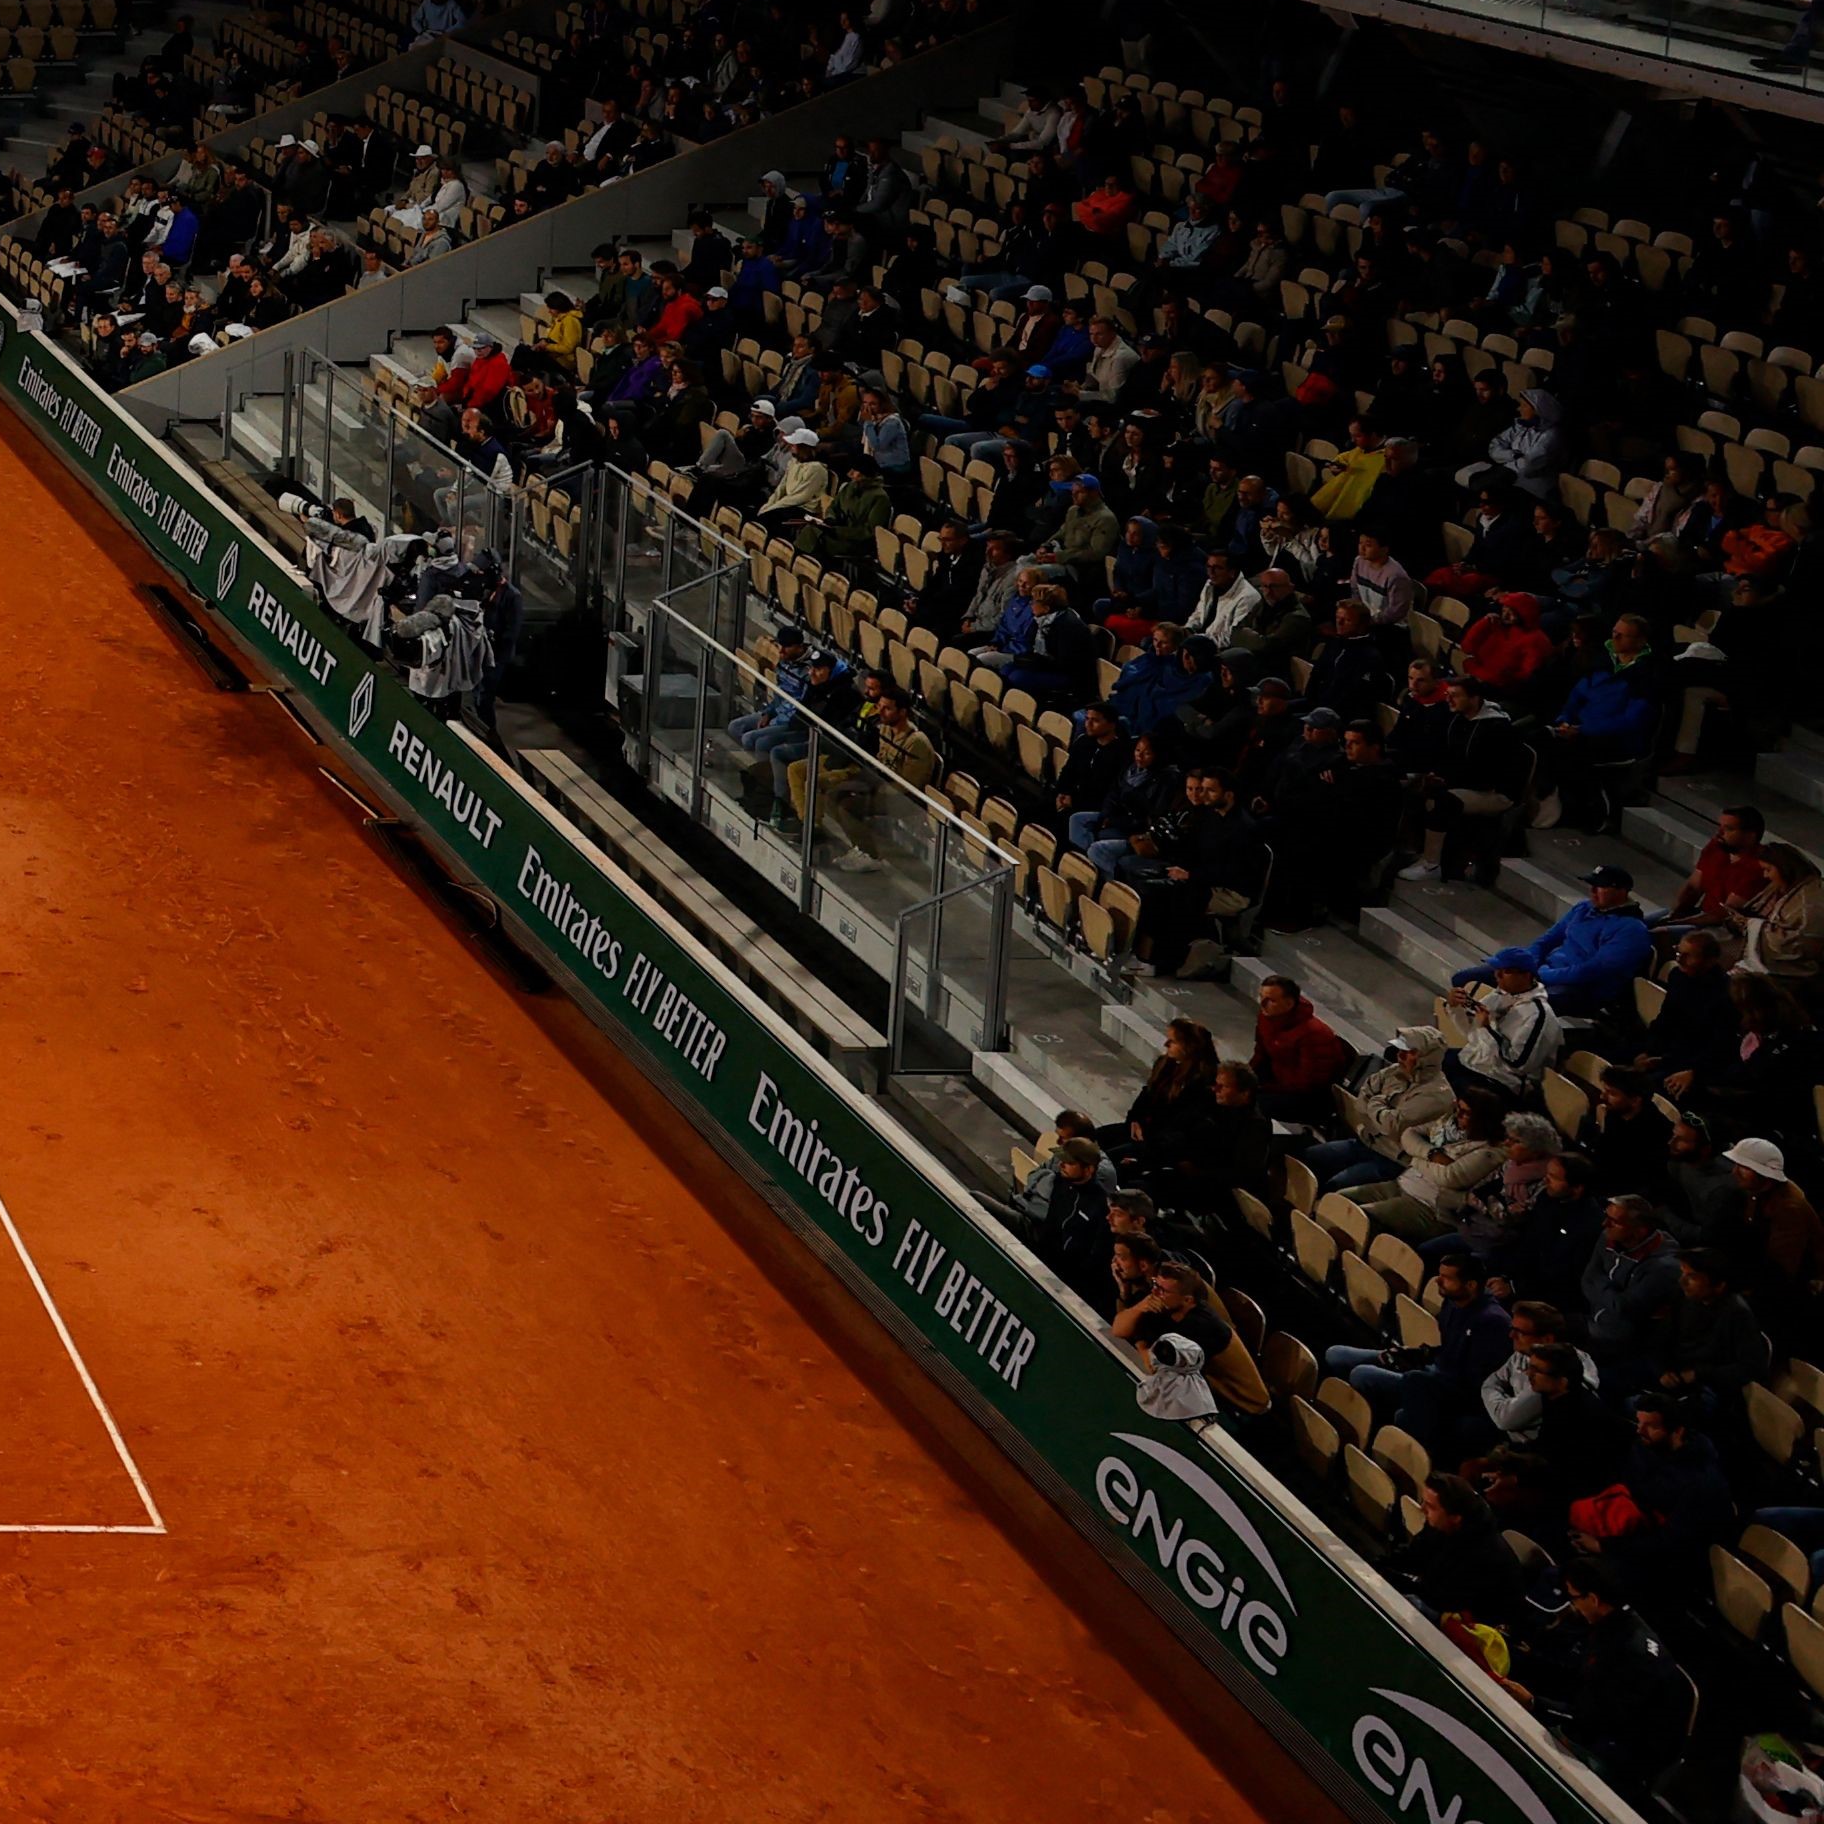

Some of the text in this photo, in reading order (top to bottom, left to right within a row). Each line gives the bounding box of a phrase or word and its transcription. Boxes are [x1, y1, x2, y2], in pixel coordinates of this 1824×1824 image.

[17, 354, 63, 421] Emirates
[69, 407, 103, 459] BETTER
[106, 442, 210, 565] Emirates FLY BETTER
[247, 581, 339, 687] RENAULT
[388, 719, 504, 849] RENAULT
[516, 844, 728, 1084] Emirates FLY BETTER
[747, 1070, 1037, 1392] Emirates FLY BETTER
